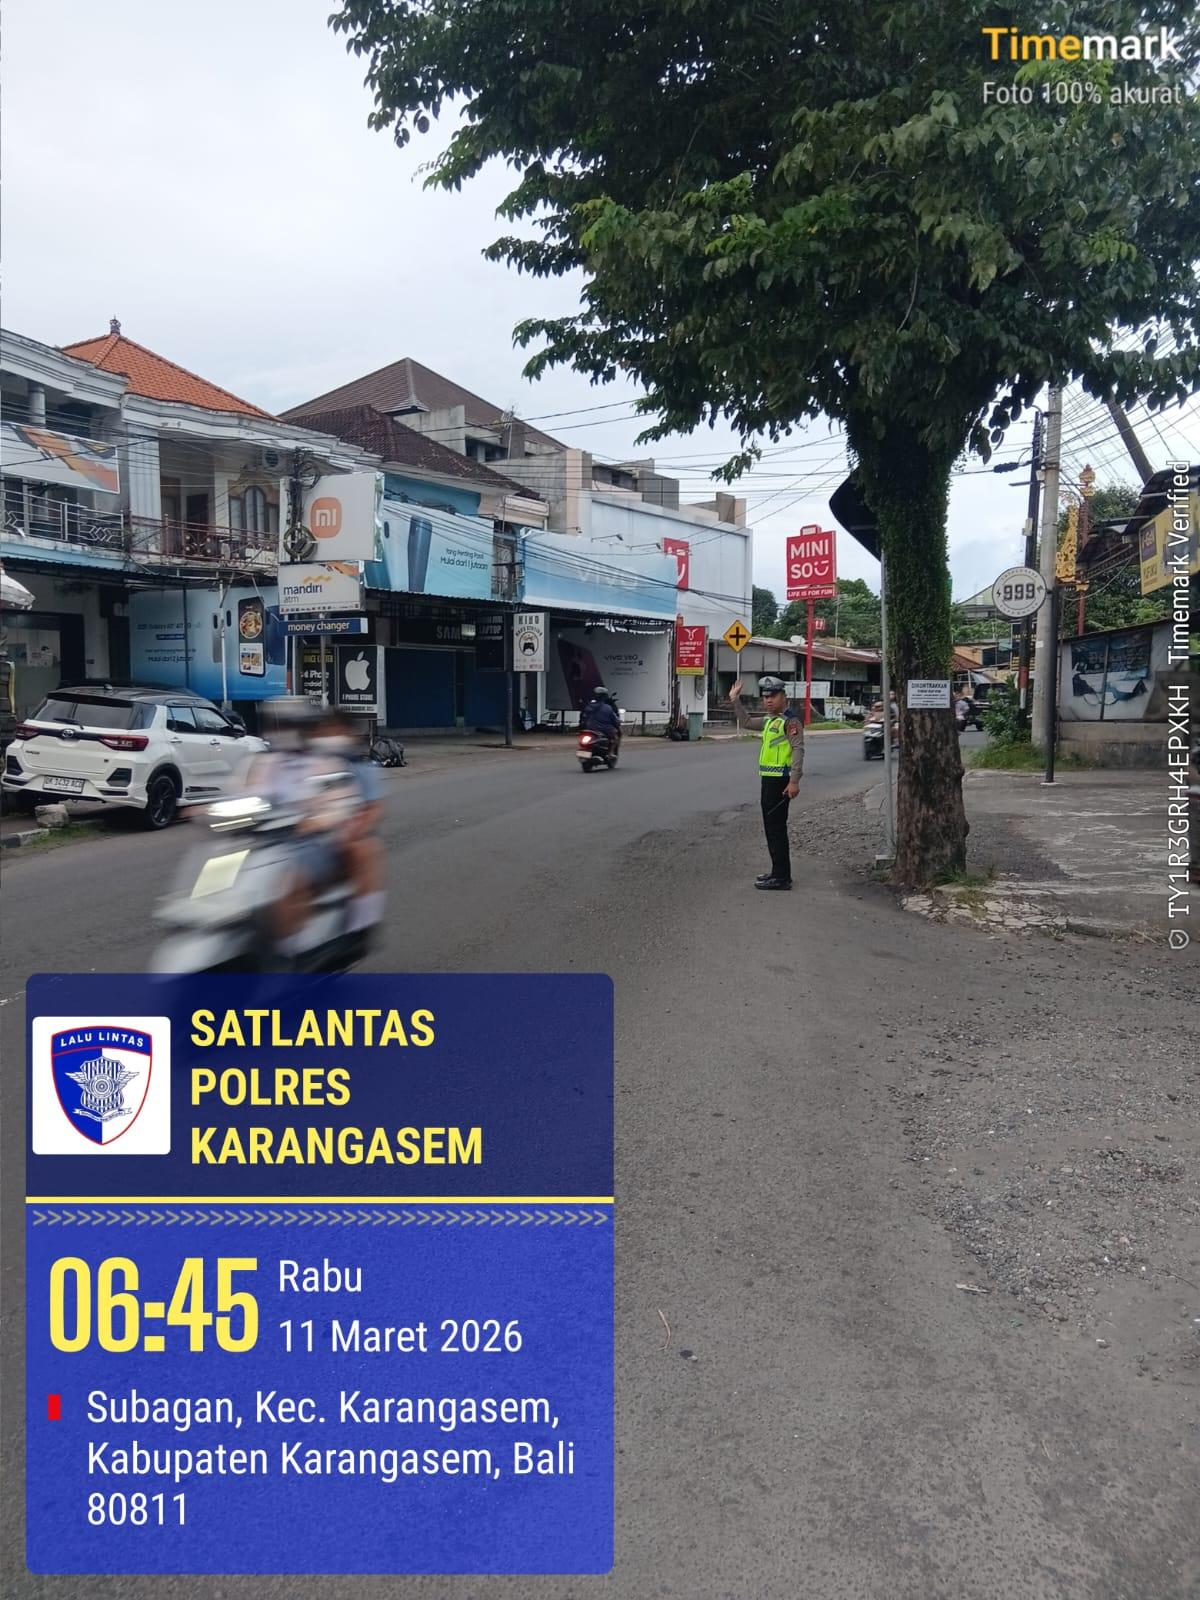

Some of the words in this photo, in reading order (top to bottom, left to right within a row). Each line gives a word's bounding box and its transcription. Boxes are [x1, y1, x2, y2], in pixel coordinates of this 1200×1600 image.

[790, 539, 829, 560] MINI
[284, 583, 322, 596] mandiri
[788, 590, 800, 598] LIFE
[808, 589, 820, 597] FOR
[821, 588, 833, 596] FUN
[1003, 583, 1035, 601] 999
[284, 595, 299, 604] atm
[288, 623, 316, 633] money
[317, 621, 350, 632] changer
